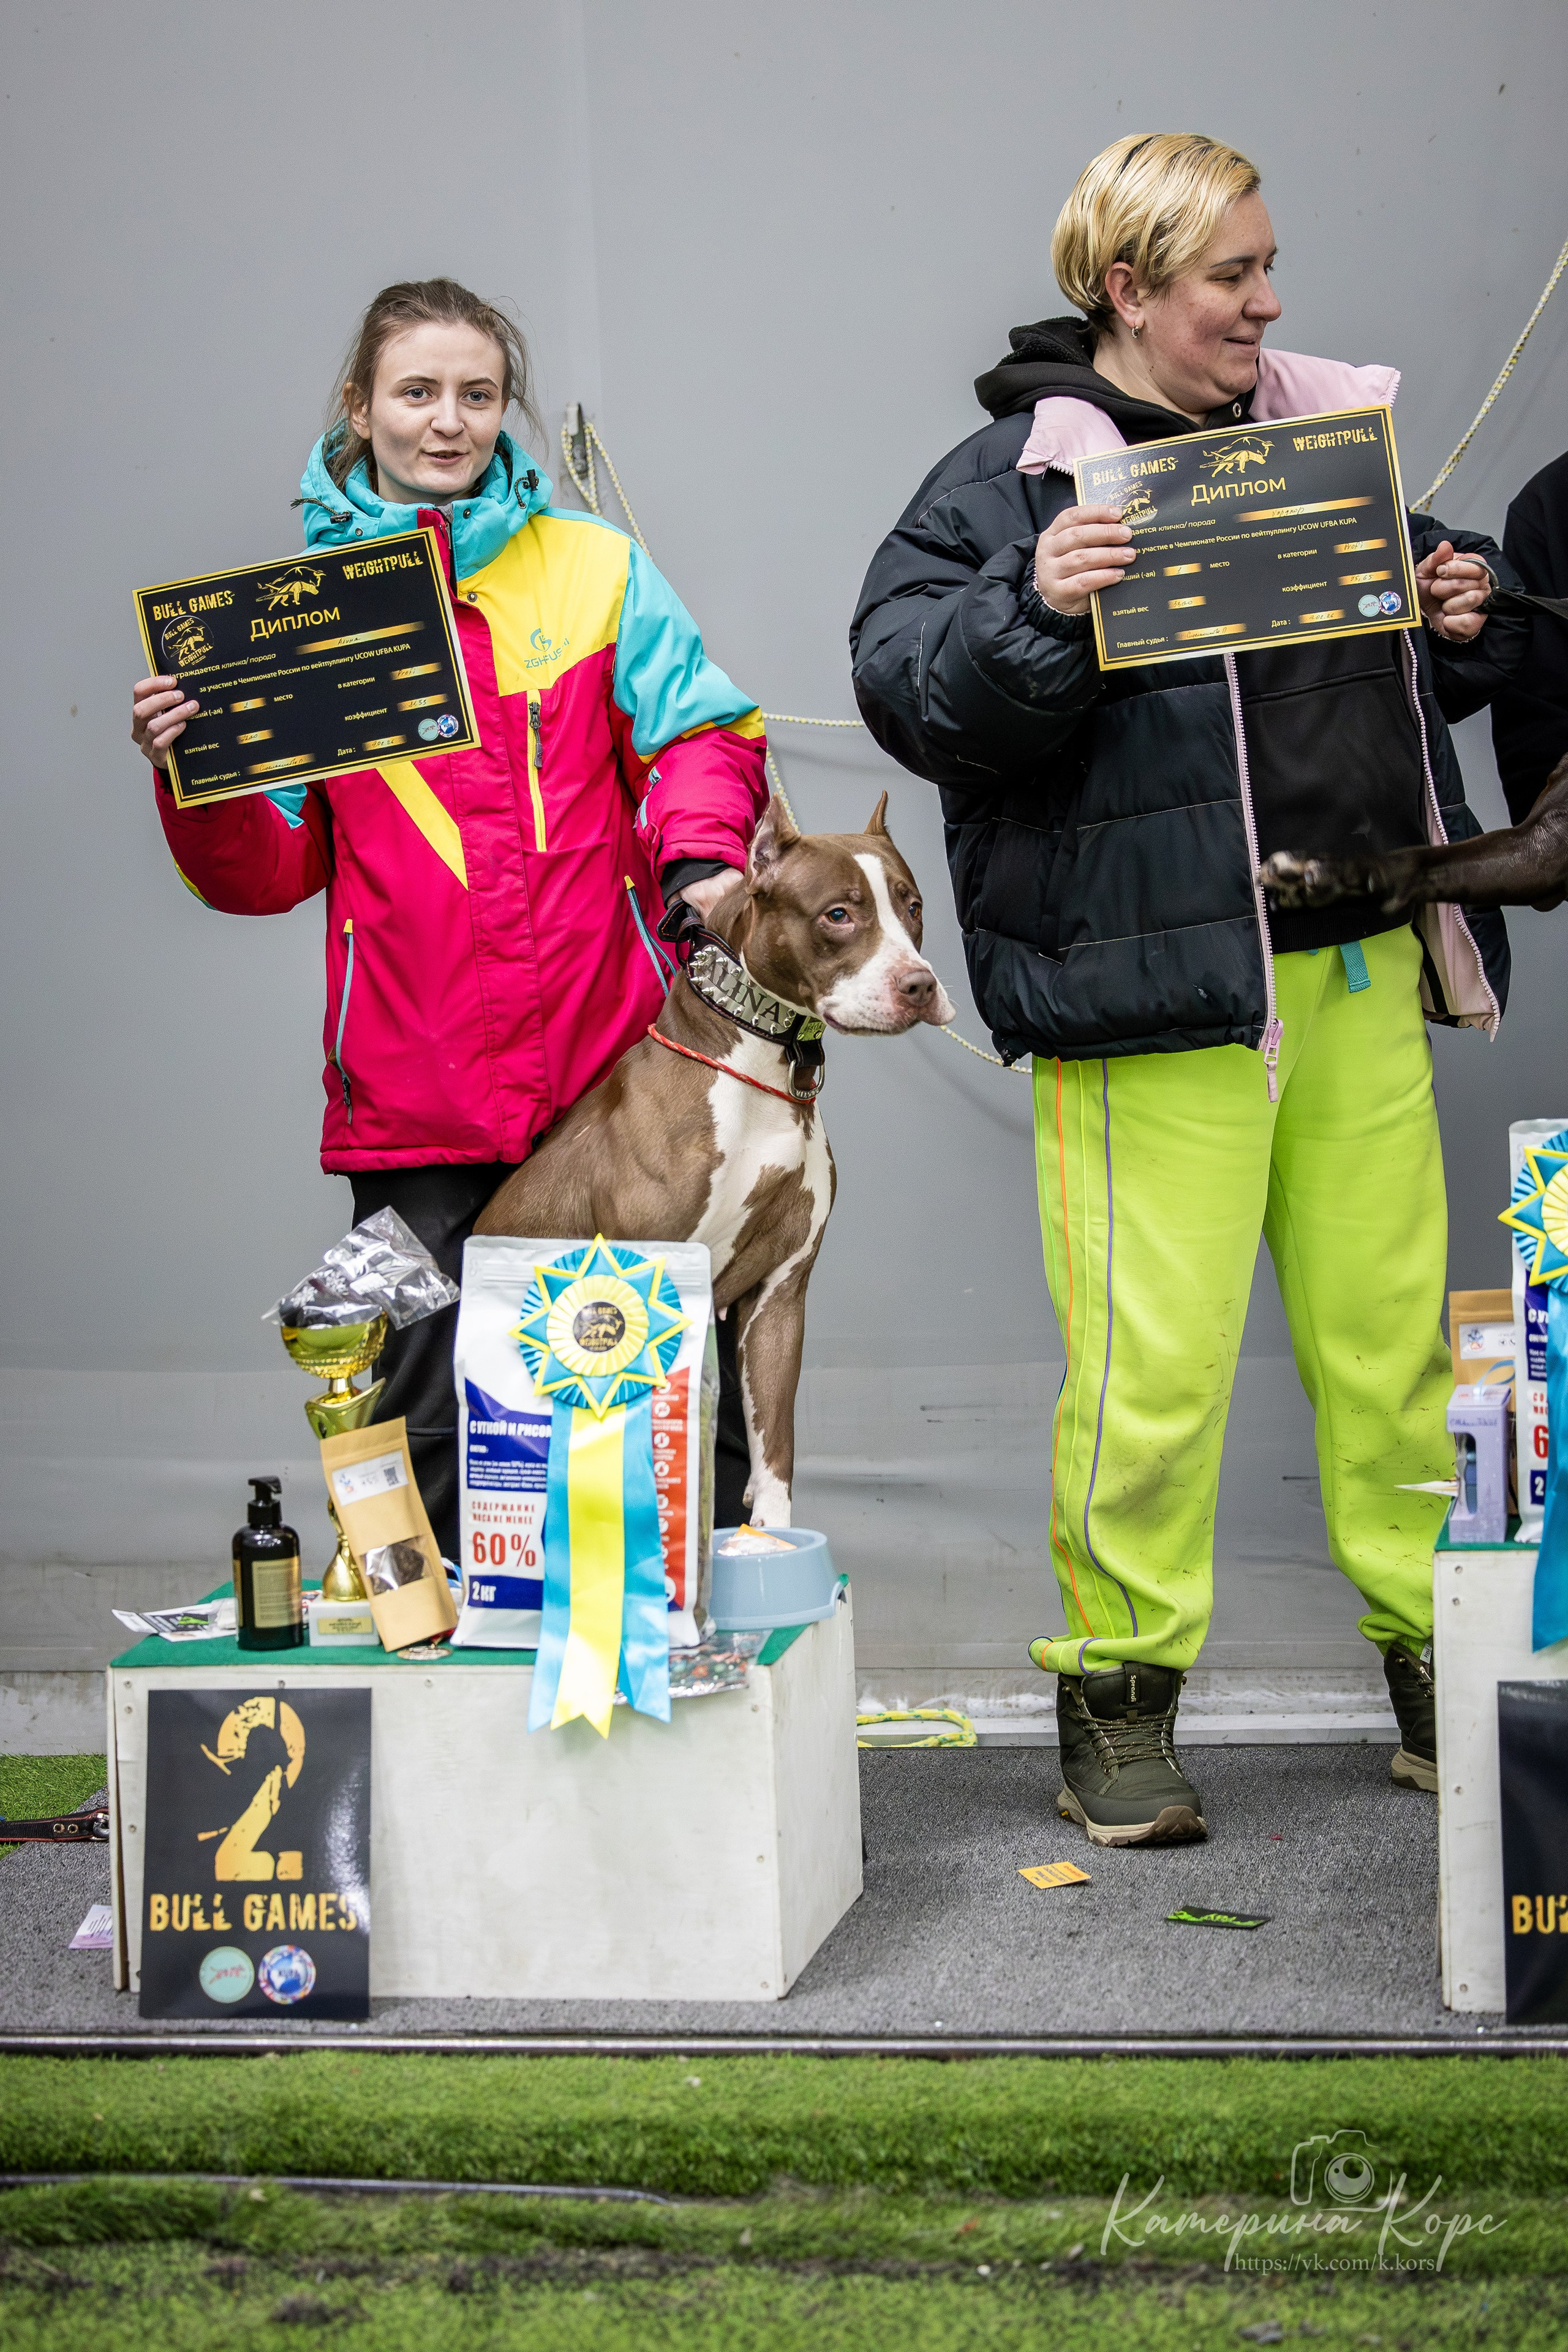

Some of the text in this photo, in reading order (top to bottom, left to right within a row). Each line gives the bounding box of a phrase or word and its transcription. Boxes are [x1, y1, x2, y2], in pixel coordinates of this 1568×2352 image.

[1292, 427, 1378, 451] WEIGHTPULL
[1092, 456, 1179, 486] BULL GAMES
[1191, 477, 1286, 507] Диплом
[1132, 527, 1156, 535] дается
[1142, 545, 1168, 554] участие
[1175, 538, 1215, 548] Чемпионате
[1251, 526, 1297, 538] вейтпуллингу
[1298, 522, 1319, 531] UCOW
[1339, 517, 1357, 526] KUPA
[1283, 549, 1317, 558] категории
[342, 551, 423, 580] WEIGHTPULL
[1141, 570, 1155, 579] (-ая)
[1282, 581, 1327, 592] коэффициент
[153, 590, 235, 620] BULL GAMES
[1112, 607, 1136, 616] взятый
[164, 617, 194, 640] BULL GAMES
[251, 606, 341, 642] Диплом
[1117, 639, 1145, 649] Главный
[1146, 637, 1164, 646] судья
[167, 665, 220, 679] аграждается
[207, 682, 232, 692] участие
[238, 672, 277, 684] Чемпионате
[278, 666, 301, 676] России
[311, 655, 354, 669] вейтпуллингу
[355, 651, 375, 660] UCOW
[375, 647, 393, 655] UFBA
[343, 677, 375, 688] категории
[209, 707, 223, 717] (-ая)
[345, 707, 387, 721] коэффициент
[184, 745, 207, 755] взятый
[191, 775, 218, 785] Главный
[219, 771, 237, 781] судья
[472, 1531, 536, 1567] 60%
[149, 1893, 233, 1932] BULL
[243, 1893, 359, 1932] GAMES
